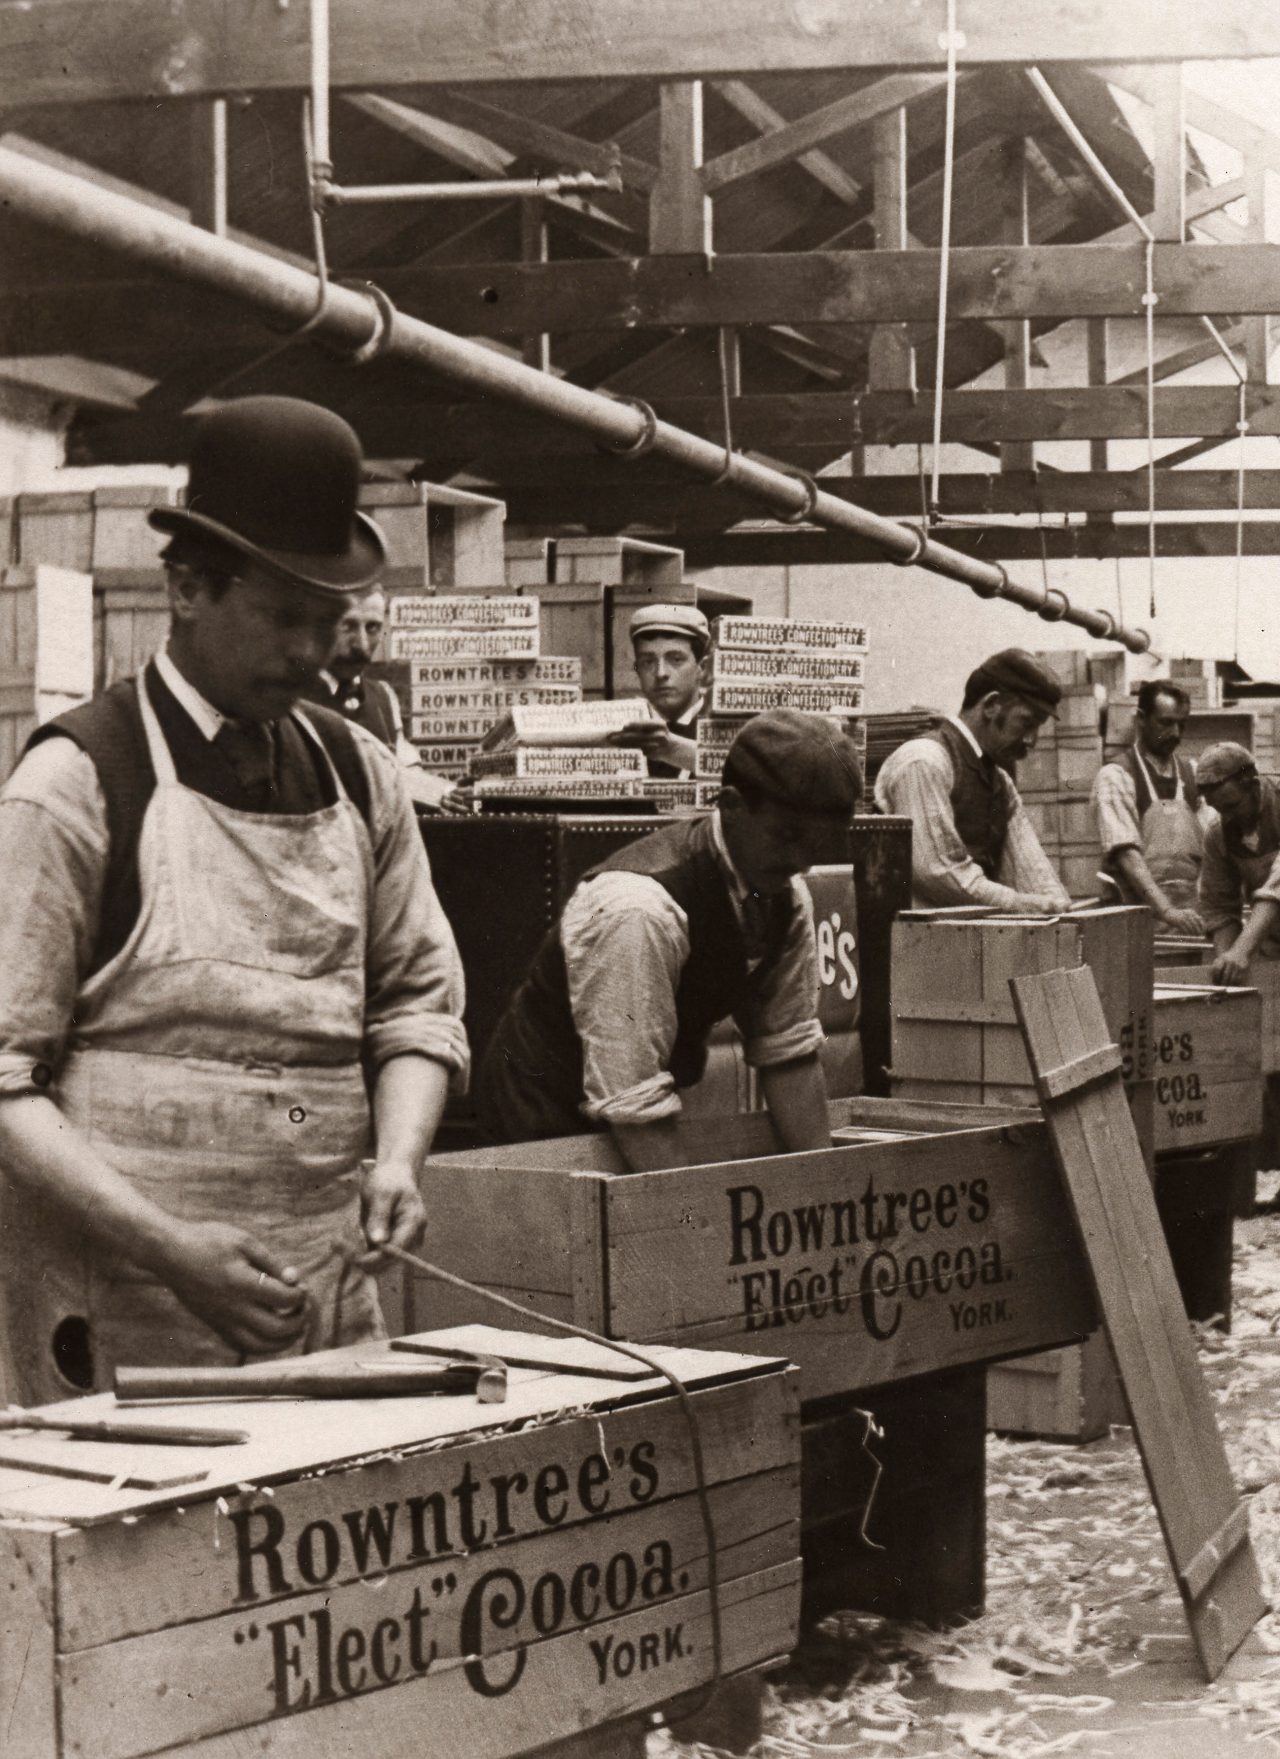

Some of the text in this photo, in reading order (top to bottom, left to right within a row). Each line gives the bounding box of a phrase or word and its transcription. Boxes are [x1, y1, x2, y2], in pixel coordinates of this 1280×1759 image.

[780, 662, 854, 678] CONFECTIONERY
[787, 630, 860, 646] CONFECTIONERY
[781, 694, 854, 709] CONFECTIONERY
[724, 1172, 991, 1267] Rowntree's
[859, 1240, 1012, 1342] Cocoa.
[949, 1300, 1013, 1332] YORK.
[229, 1439, 660, 1607] Rowntree's
[233, 1538, 691, 1719] "Elect" Cocoa.
[589, 1621, 694, 1686] YORK.
